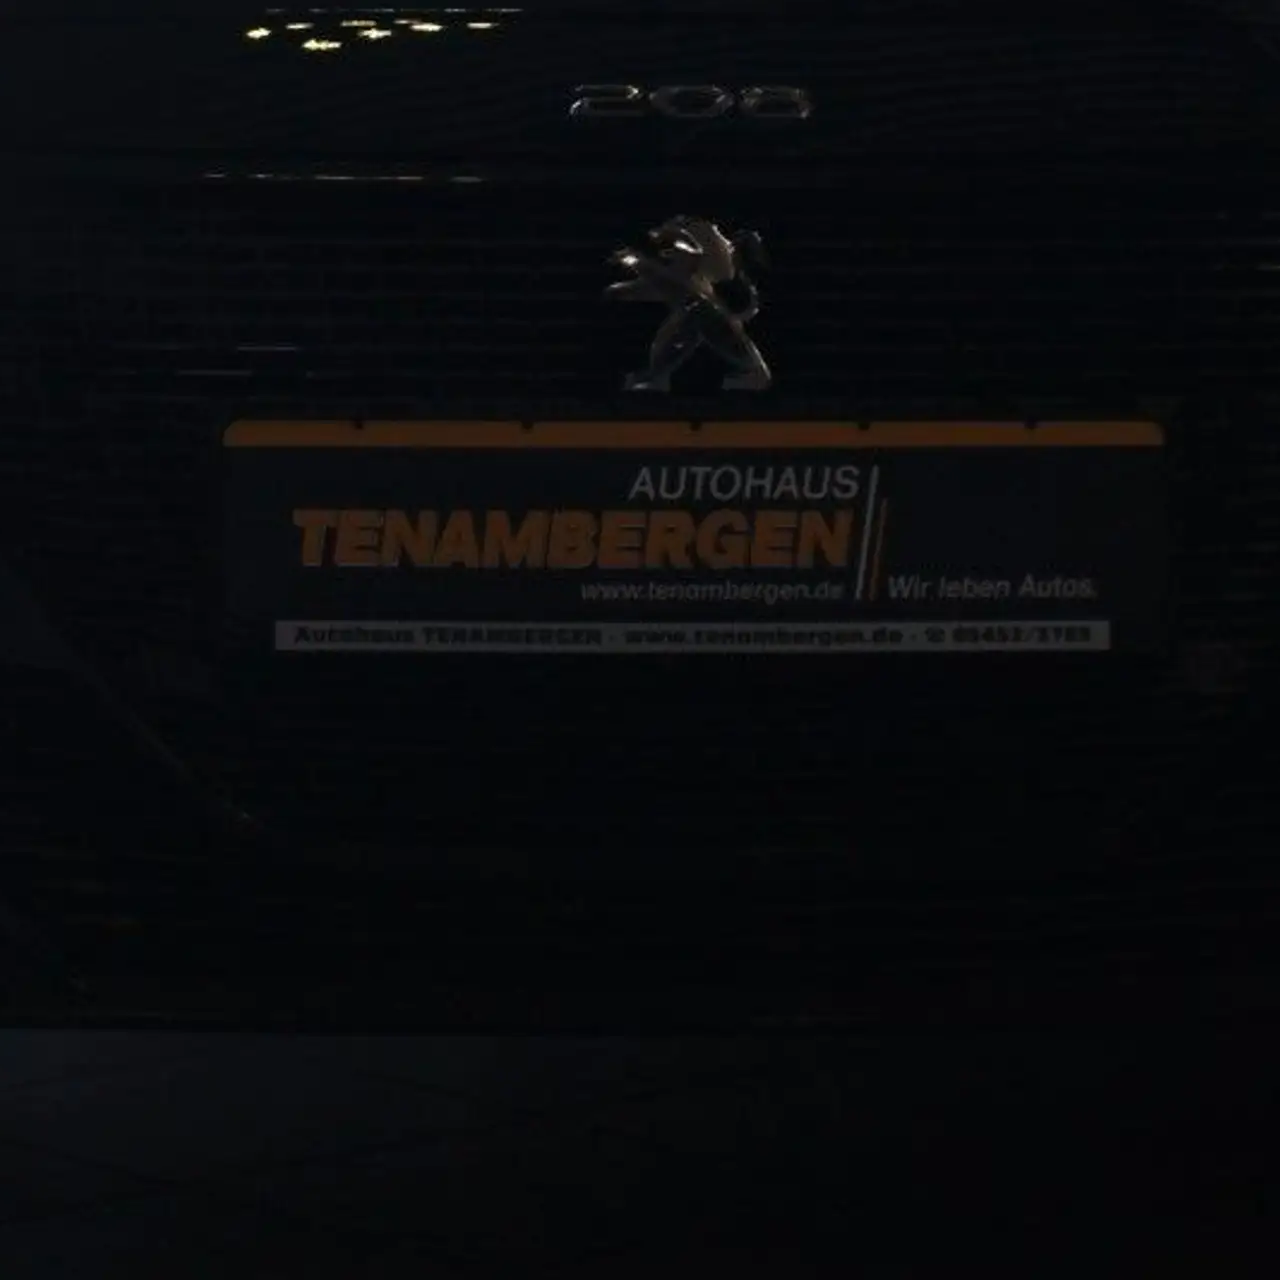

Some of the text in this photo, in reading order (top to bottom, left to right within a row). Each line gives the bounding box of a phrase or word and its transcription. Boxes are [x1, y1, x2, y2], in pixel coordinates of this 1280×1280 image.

[628, 465, 861, 501] AUTOHAUS
[292, 507, 855, 570] TENAMBERGEN
[580, 580, 844, 605] www.tenambergen.de
[886, 573, 1098, 600] Wir leben Autos.
